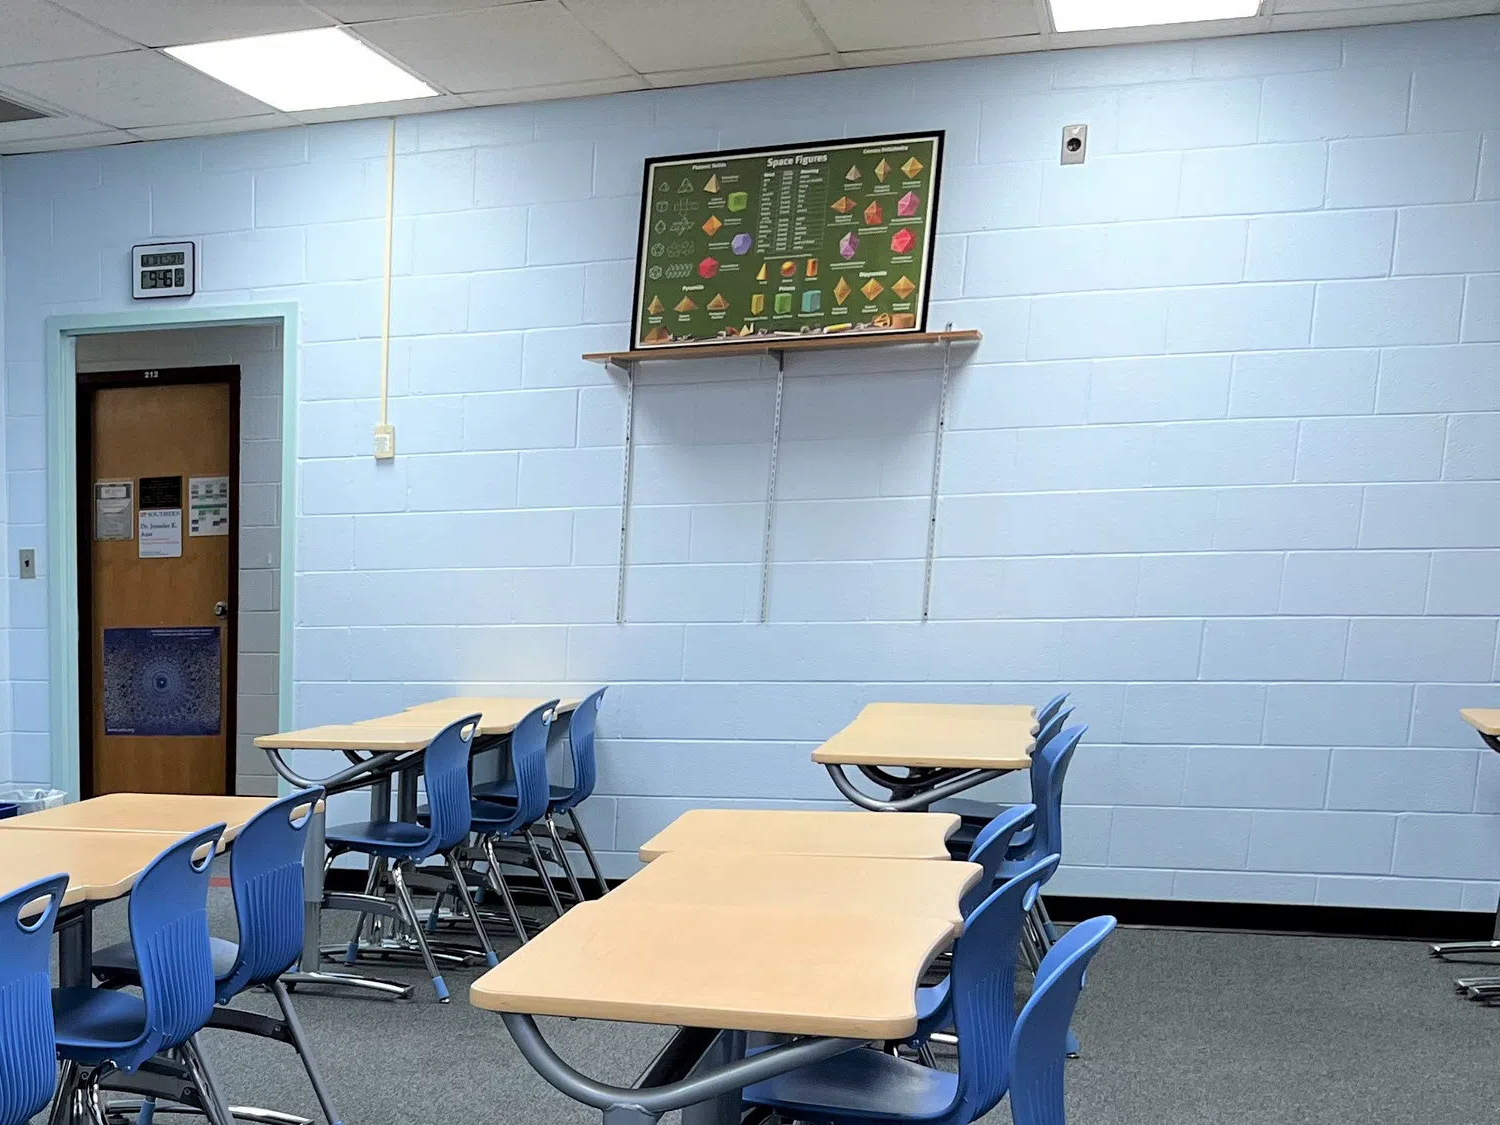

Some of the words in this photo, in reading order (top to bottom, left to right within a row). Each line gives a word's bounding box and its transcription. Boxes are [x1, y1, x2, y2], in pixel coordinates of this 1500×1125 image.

[767, 157, 794, 168] Space
[795, 154, 828, 165] Figures
[144, 370, 159, 379] 212
